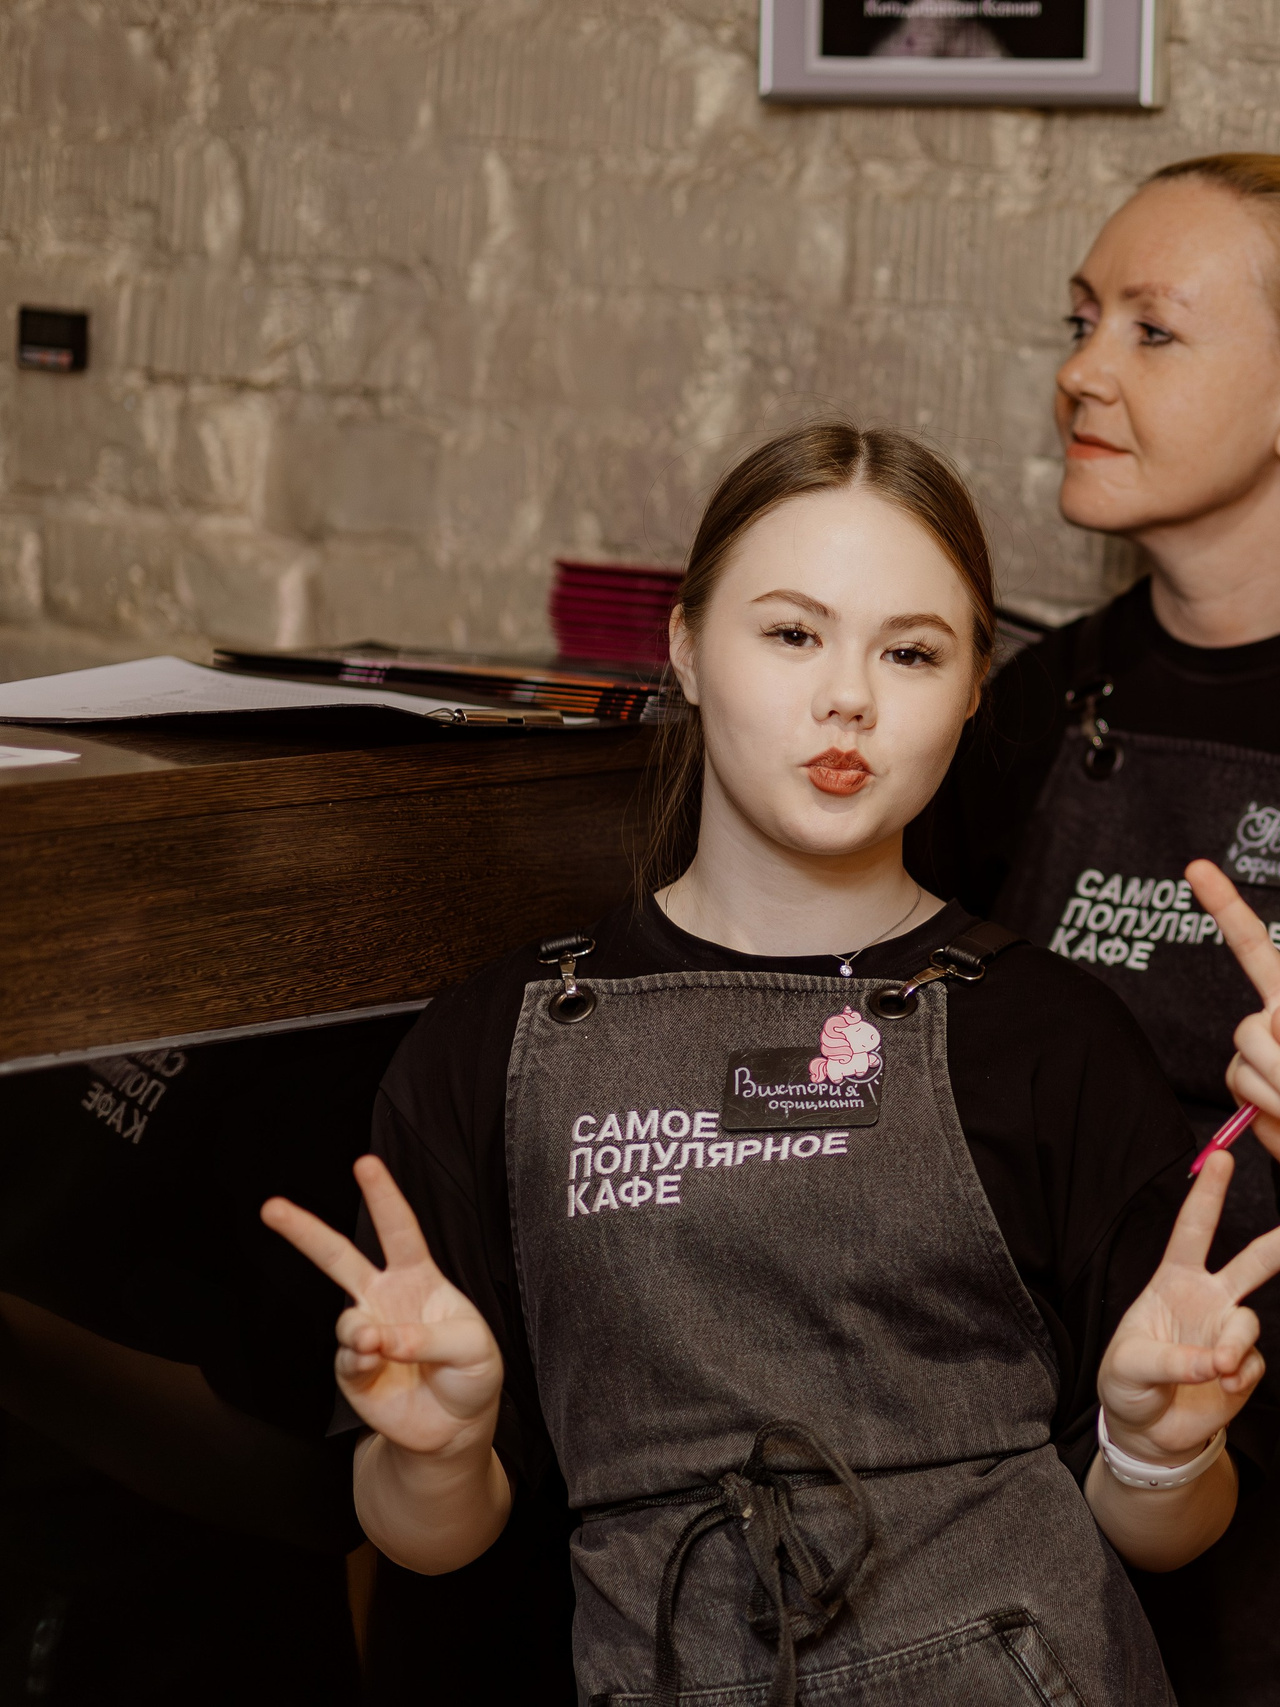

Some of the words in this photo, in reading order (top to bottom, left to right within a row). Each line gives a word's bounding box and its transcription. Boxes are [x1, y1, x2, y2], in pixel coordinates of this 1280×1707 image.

[1076, 868, 1193, 911] САМОЕ
[1049, 926, 1155, 971] КАФЕ
[735, 1067, 860, 1098] Виктория
[571, 1109, 719, 1143] САМОЕ
[768, 1099, 865, 1118] официант
[569, 1132, 849, 1180] ПОПУЛЯРНОЕ
[567, 1175, 681, 1217] КАФЕ
